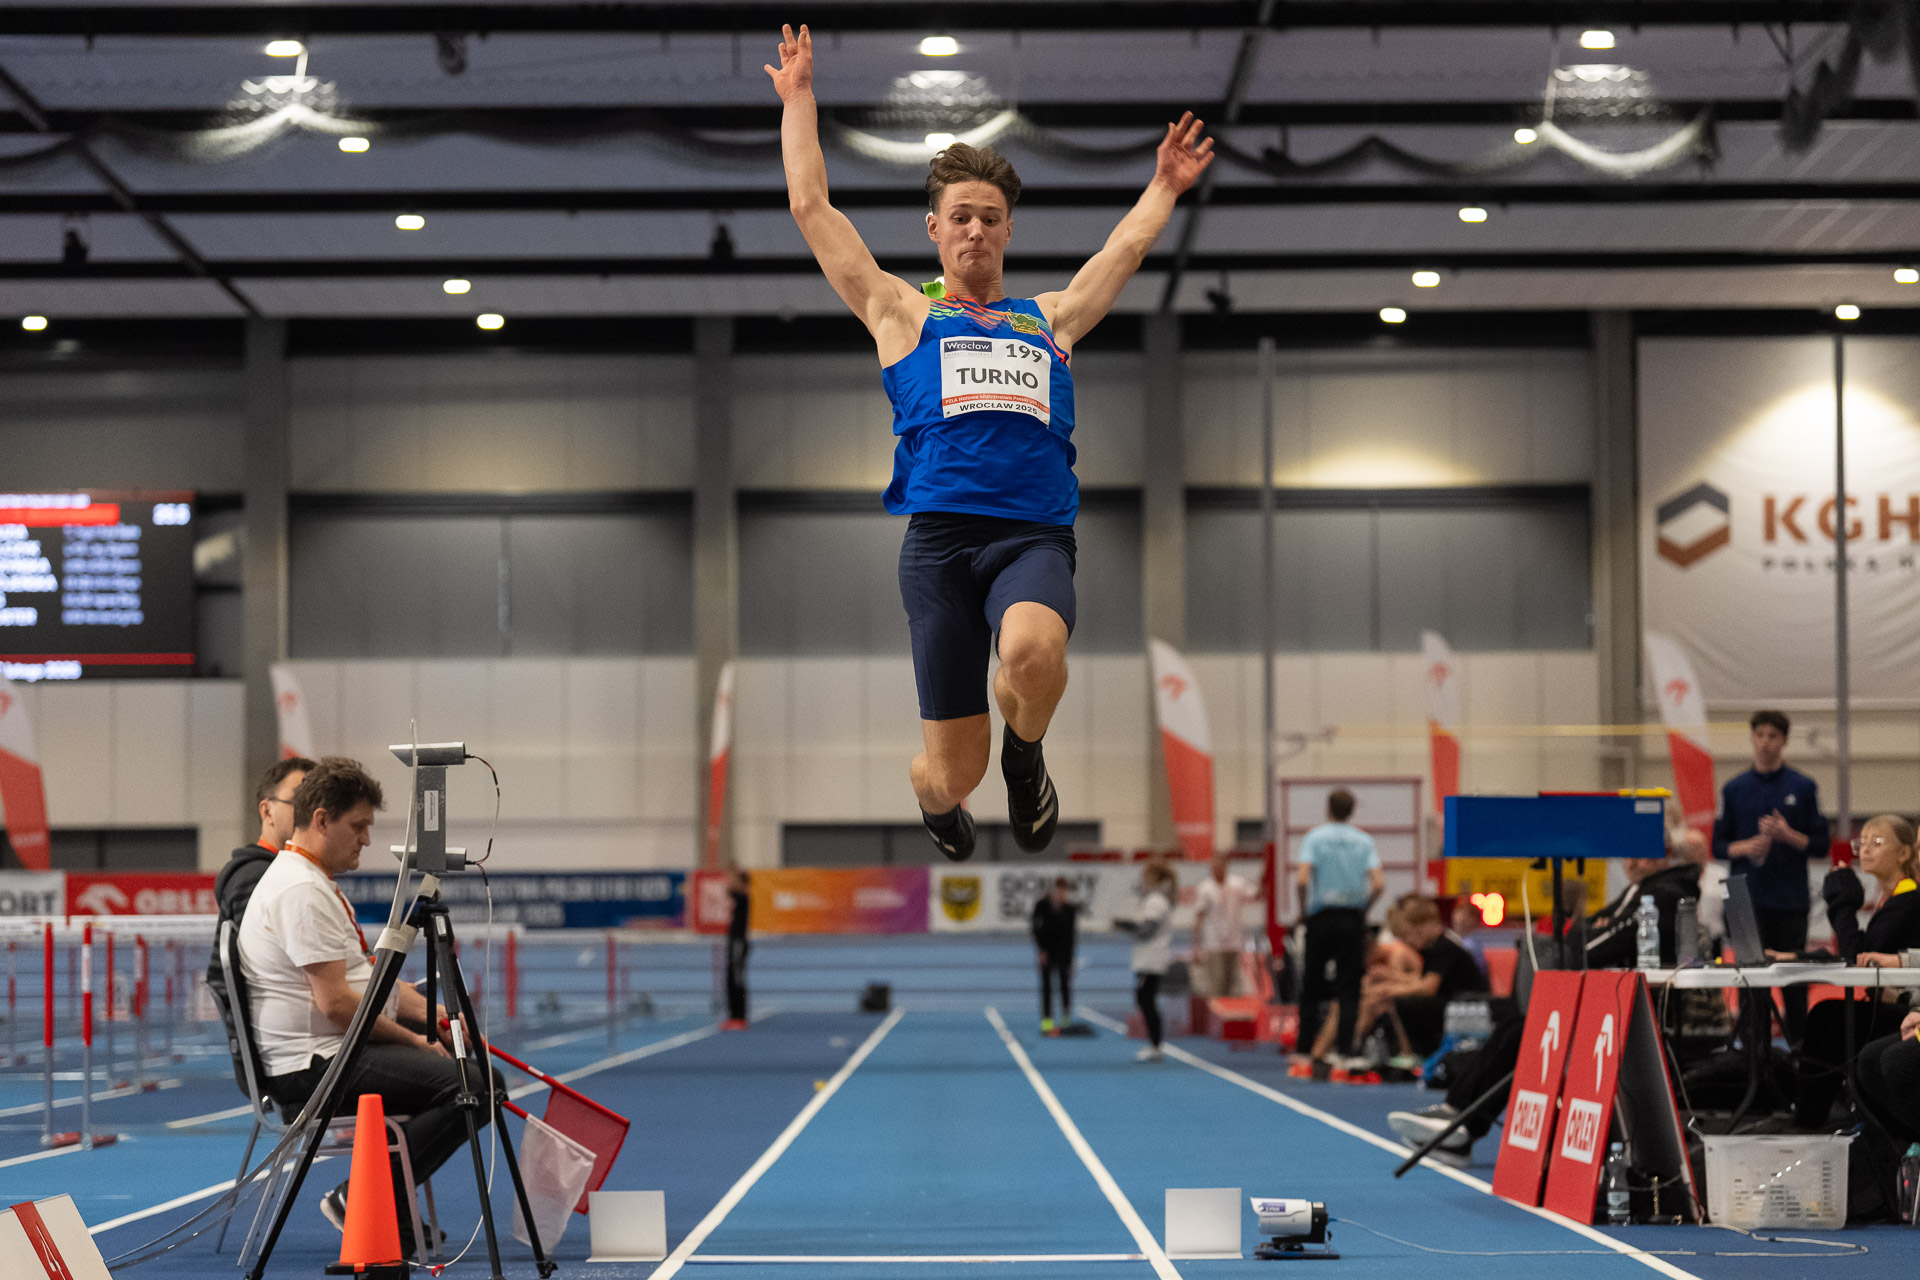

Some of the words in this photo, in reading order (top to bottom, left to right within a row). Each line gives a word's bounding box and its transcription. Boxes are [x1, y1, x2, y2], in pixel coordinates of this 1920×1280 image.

[946, 341, 990, 350] Wrocław
[1005, 343, 1043, 363] 199
[956, 367, 1039, 389] TURNO
[960, 402, 1014, 412] WROCŁAW
[1016, 404, 1038, 415] 2025
[134, 888, 217, 915] ORLE
[1513, 1099, 1544, 1141] ORLEN
[1566, 1108, 1599, 1152] ORLEN
